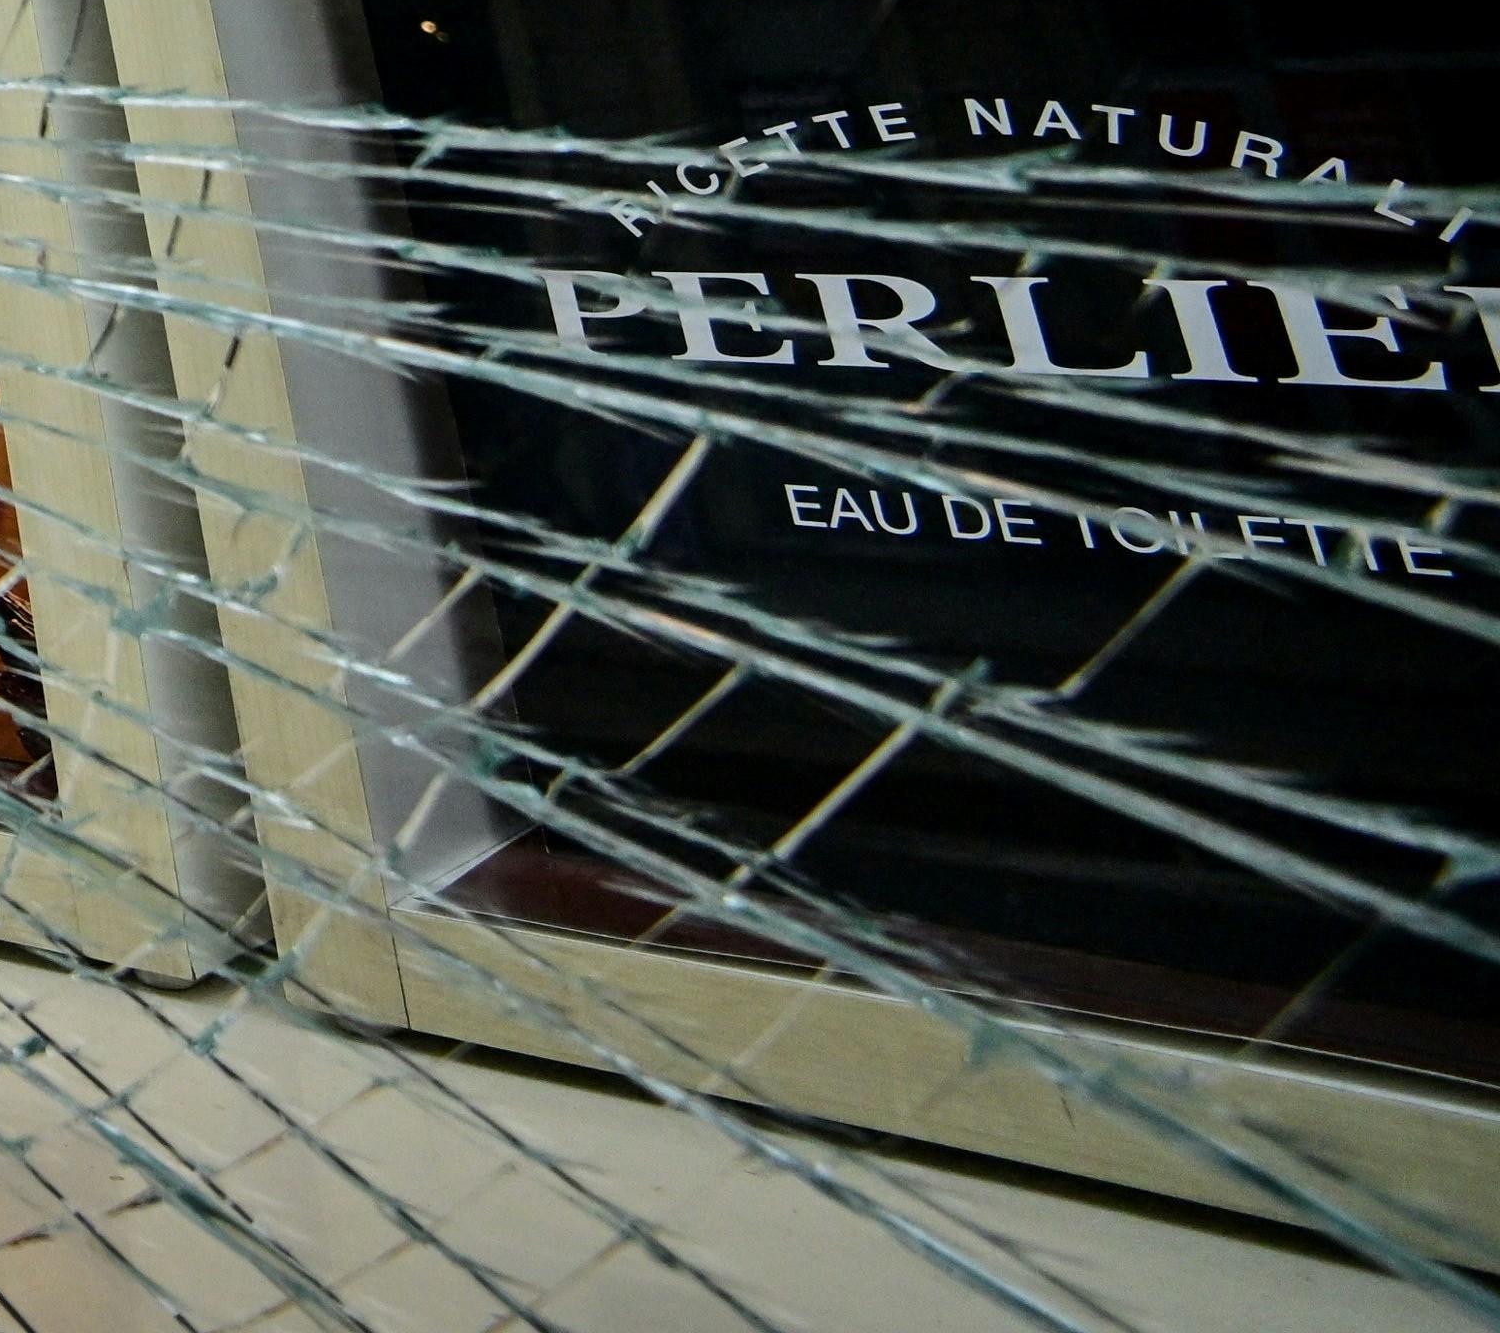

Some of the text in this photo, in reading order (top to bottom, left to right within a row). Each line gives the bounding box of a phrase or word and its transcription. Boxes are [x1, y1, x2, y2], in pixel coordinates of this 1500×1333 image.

[609, 96, 1474, 244] RICETTE NATURALI
[783, 482, 1454, 579] EAU DE TOILETTE
